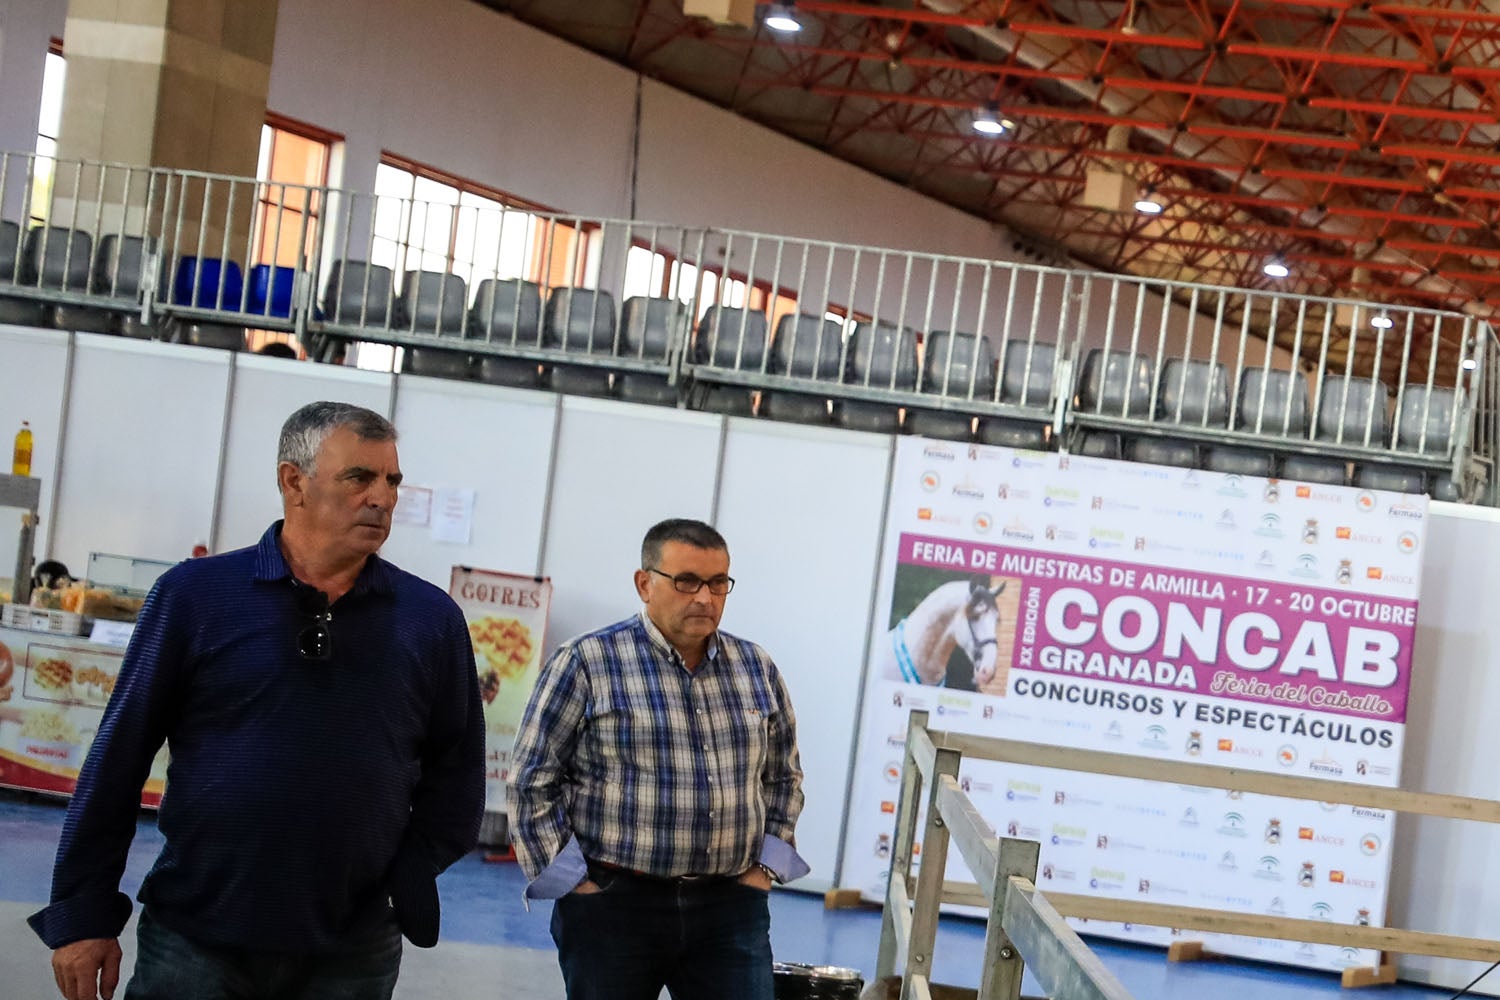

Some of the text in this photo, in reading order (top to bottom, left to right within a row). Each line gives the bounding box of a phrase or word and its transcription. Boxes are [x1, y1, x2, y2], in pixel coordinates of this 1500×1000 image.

[460, 581, 542, 609] GOFRES
[912, 541, 966, 566] FERIA
[971, 550, 997, 570] DE
[1001, 553, 1104, 585] MUESTRAS
[1109, 568, 1136, 588] DE
[1140, 570, 1226, 600] ARMILLA
[1245, 586, 1269, 605] 17
[1288, 592, 1315, 612] 20
[1320, 596, 1417, 626] OCTUBRE
[1020, 586, 1041, 667] XX EDICIÓN
[1044, 586, 1401, 688] CONCAB
[1039, 646, 1198, 690] GRANADA
[1209, 670, 1393, 715] Feria del Caballo
[1013, 677, 1394, 749] CONCURSOS Y ESPECTÁCULOS
